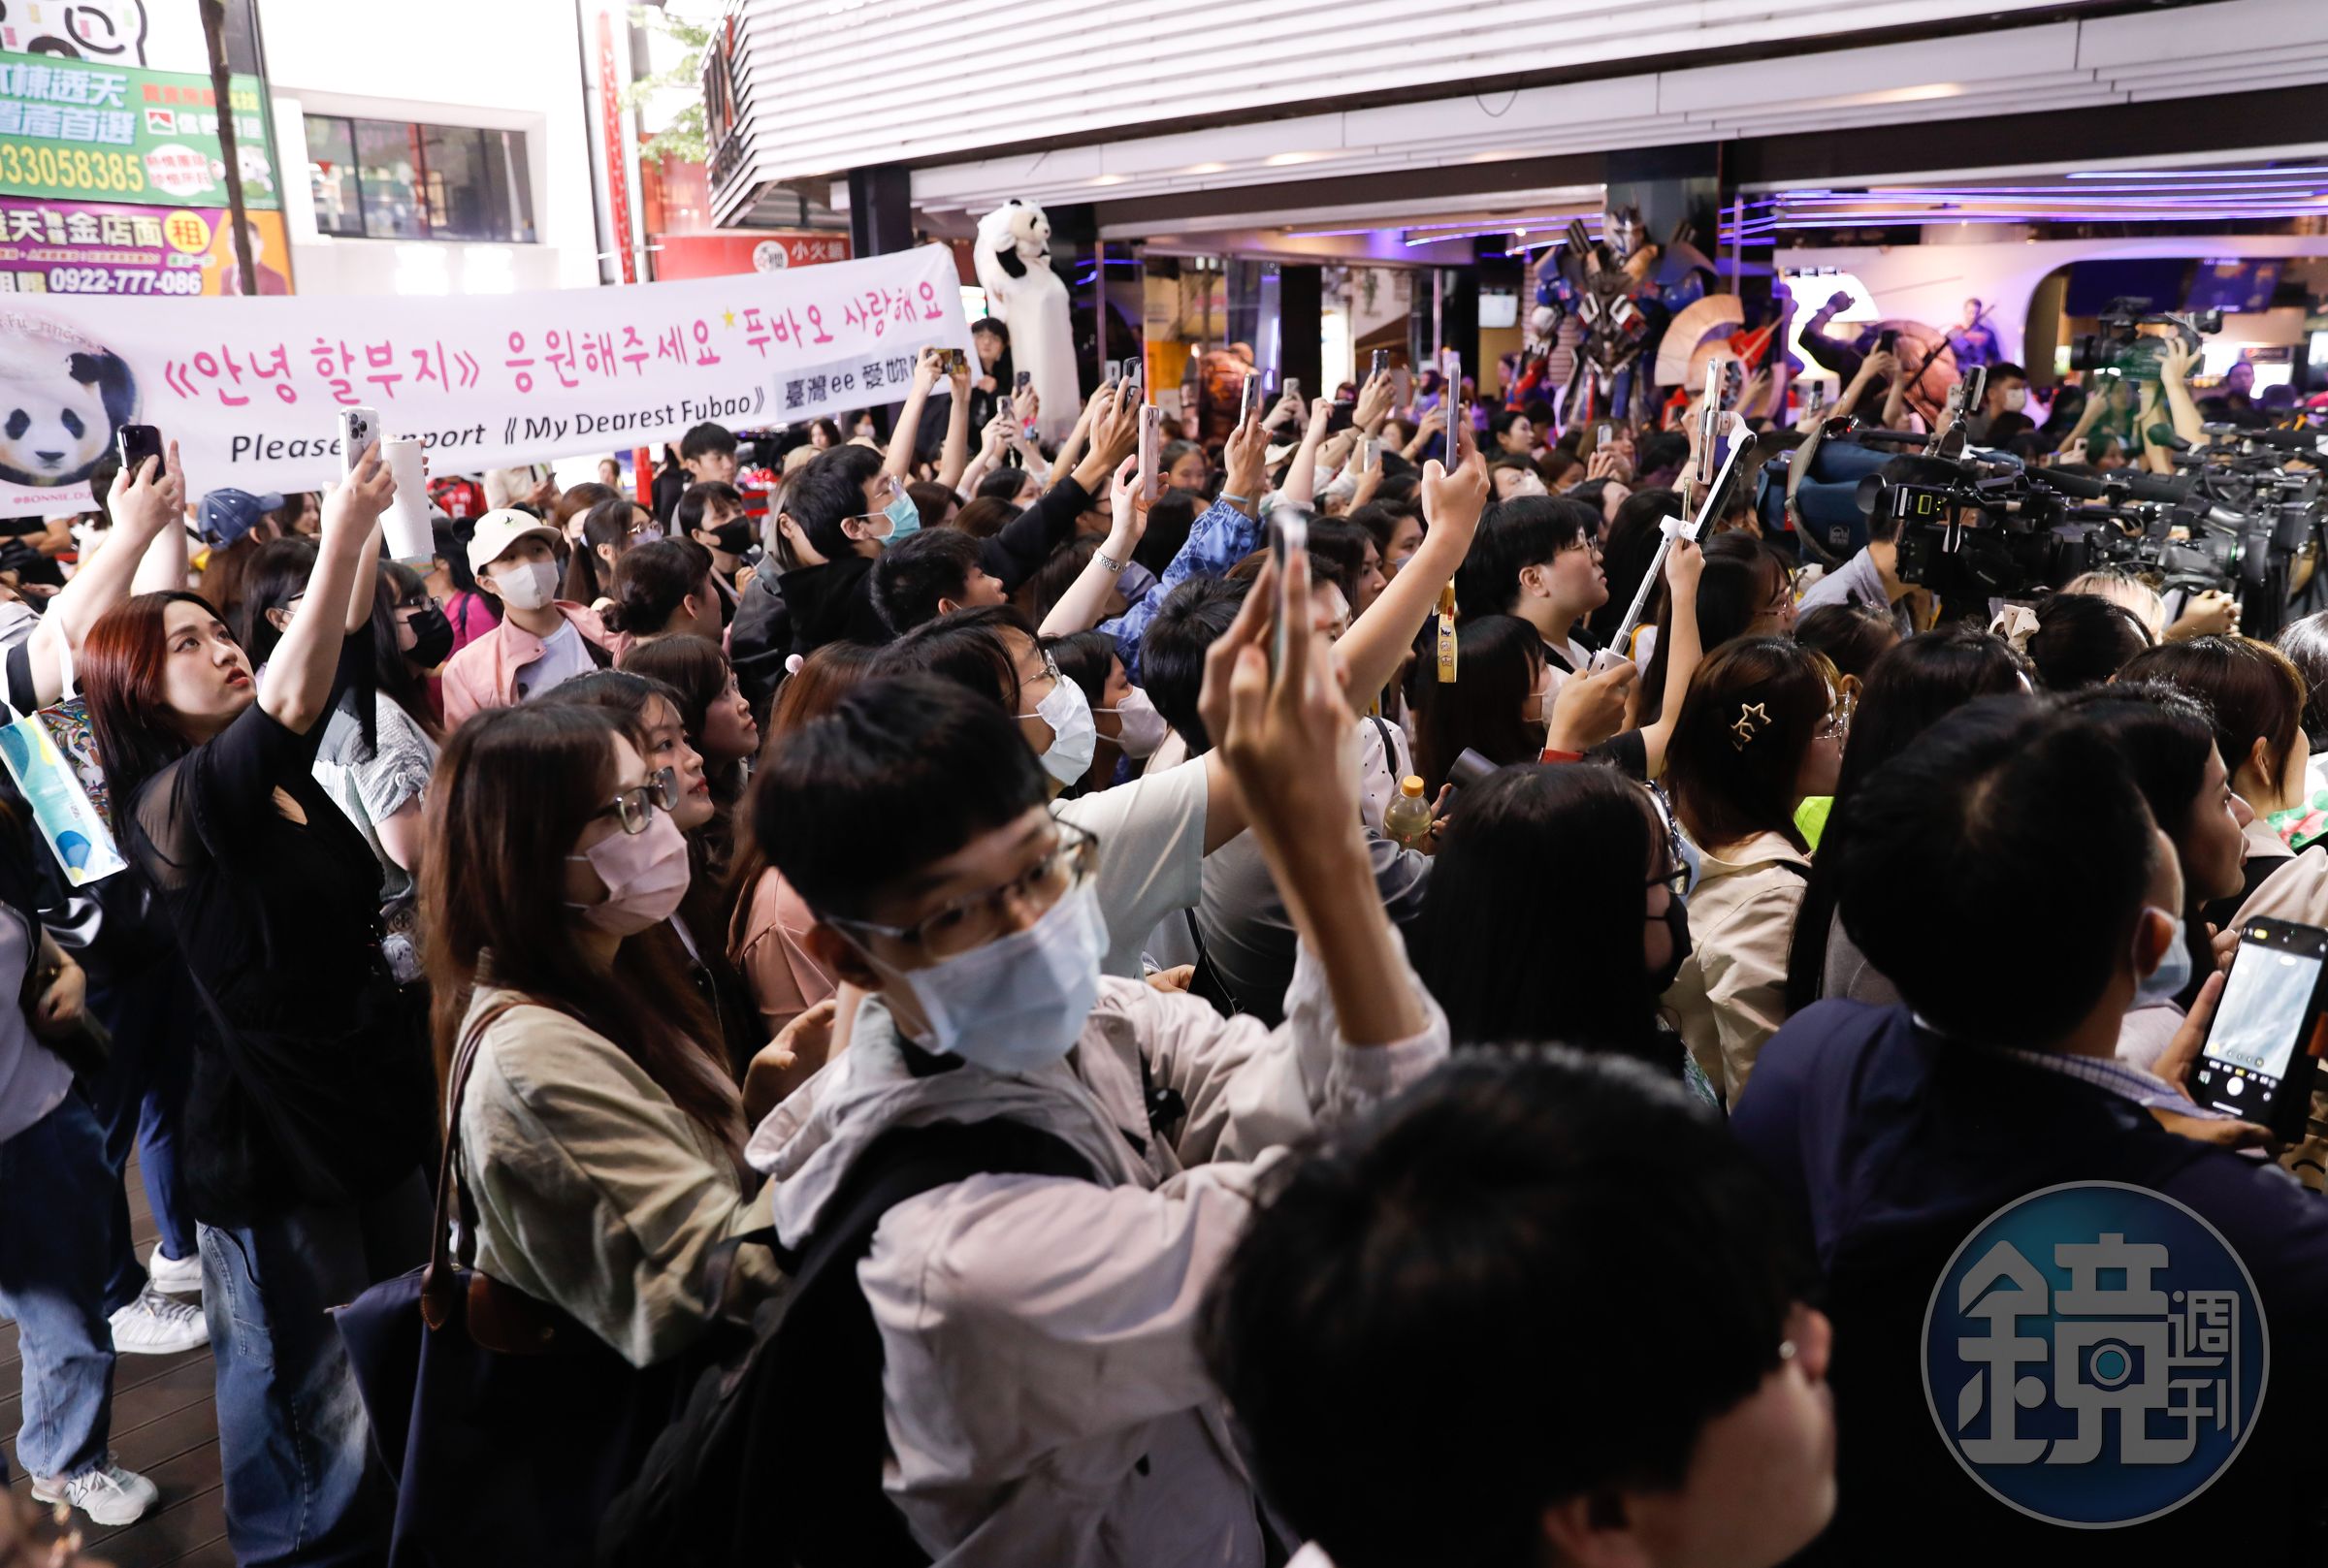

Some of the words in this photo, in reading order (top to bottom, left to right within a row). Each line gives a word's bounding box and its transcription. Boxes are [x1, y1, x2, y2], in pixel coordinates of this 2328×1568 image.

[0, 143, 145, 192] 33058385
[173, 219, 203, 245] 租
[49, 267, 202, 294] 0922-777-086
[165, 342, 297, 405] 《안녕
[310, 336, 479, 404] 할부지》
[505, 319, 721, 393] 응원해주세요
[743, 304, 833, 357] 푸바오
[844, 281, 943, 337] 사랑해요
[232, 433, 341, 463] Please
[575, 403, 674, 435] Dearest
